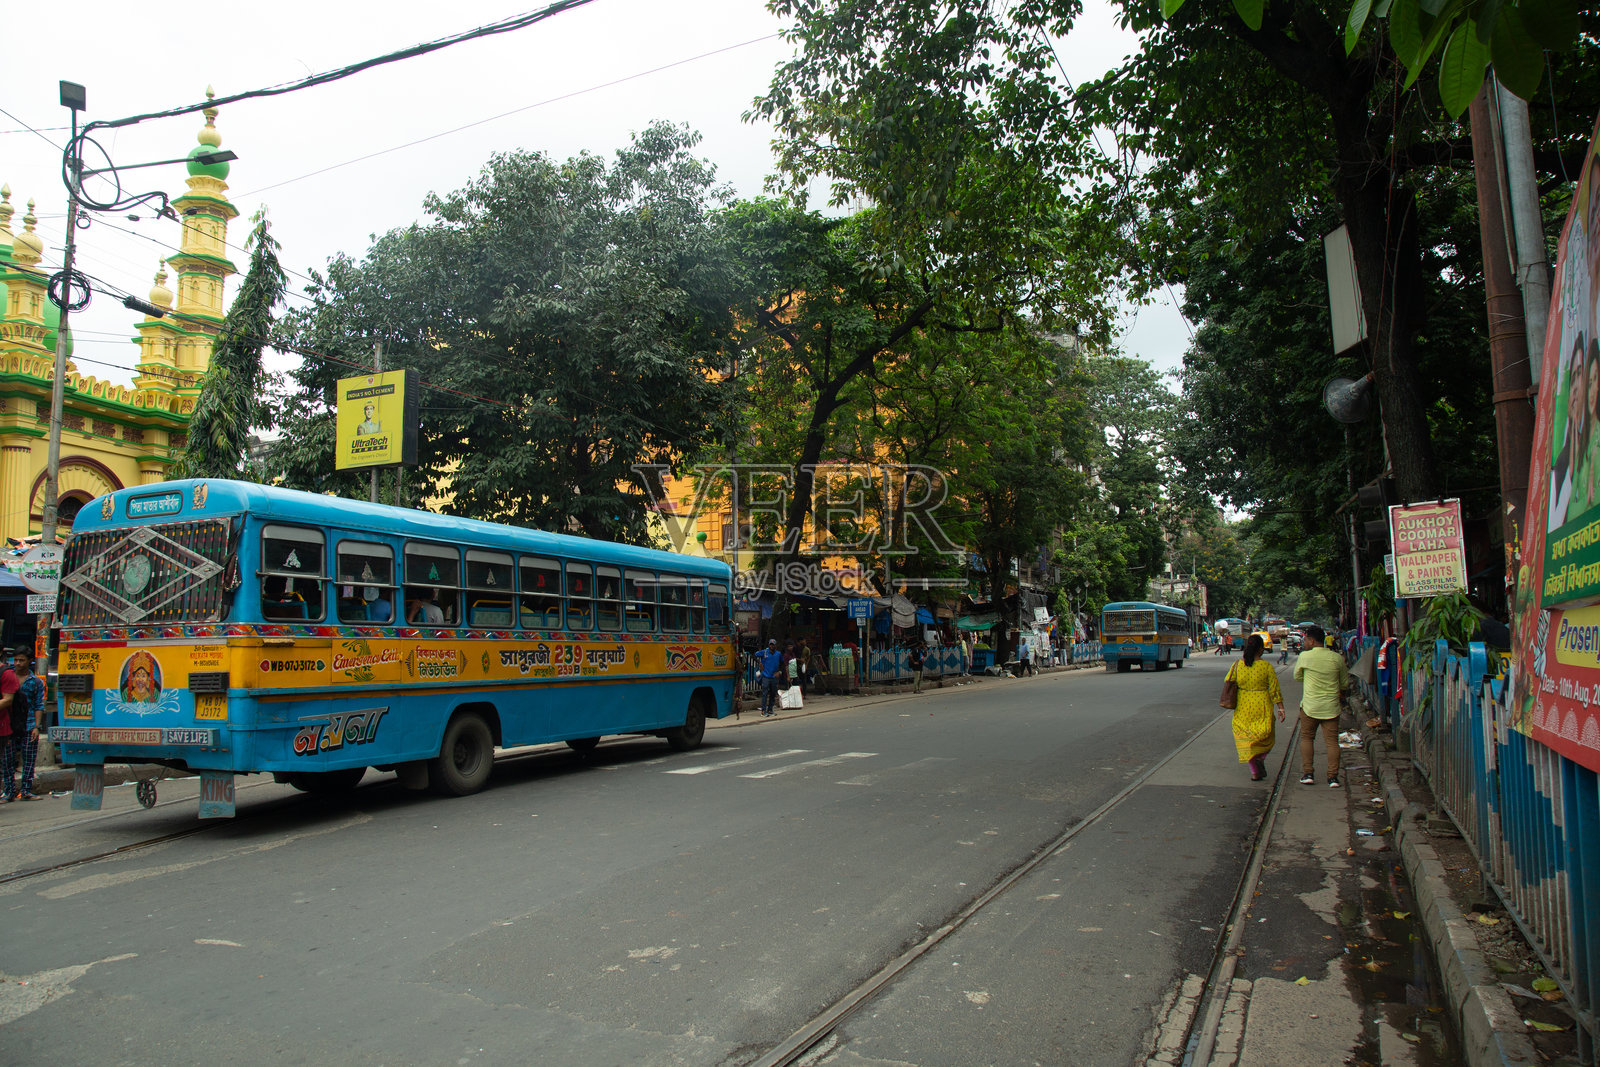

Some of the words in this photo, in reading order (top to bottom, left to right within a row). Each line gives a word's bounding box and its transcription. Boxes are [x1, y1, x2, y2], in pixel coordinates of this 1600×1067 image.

[376, 386, 394, 394] CEMENT
[352, 436, 388, 448] UltraTech
[130, 499, 142, 514] পিতা
[1398, 515, 1456, 530] AUKHOY
[1398, 527, 1456, 542] COOMAR
[1410, 540, 1447, 552] LAHA
[1400, 552, 1457, 567] WALLPAPER
[1408, 569, 1414, 580] &
[1418, 566, 1452, 578] PAINTS
[1405, 578, 1432, 587] GLASS
[1434, 576, 1457, 584] FILMS
[1408, 583, 1455, 592] FLOORINGS
[554, 644, 583, 666] 239
[332, 654, 380, 672] Emergency
[1542, 674, 1555, 694] Date
[1560, 678, 1572, 699] 10th
[1574, 680, 1590, 708] Aug.
[68, 702, 92, 716] STOP
[200, 707, 220, 718] J3172
[52, 730, 66, 740] SAFE
[114, 730, 136, 742] TRAFFIC
[168, 731, 190, 744] SAVE
[190, 732, 208, 744] LIFE
[75, 774, 102, 795] ROAD
[202, 778, 234, 802] KING
